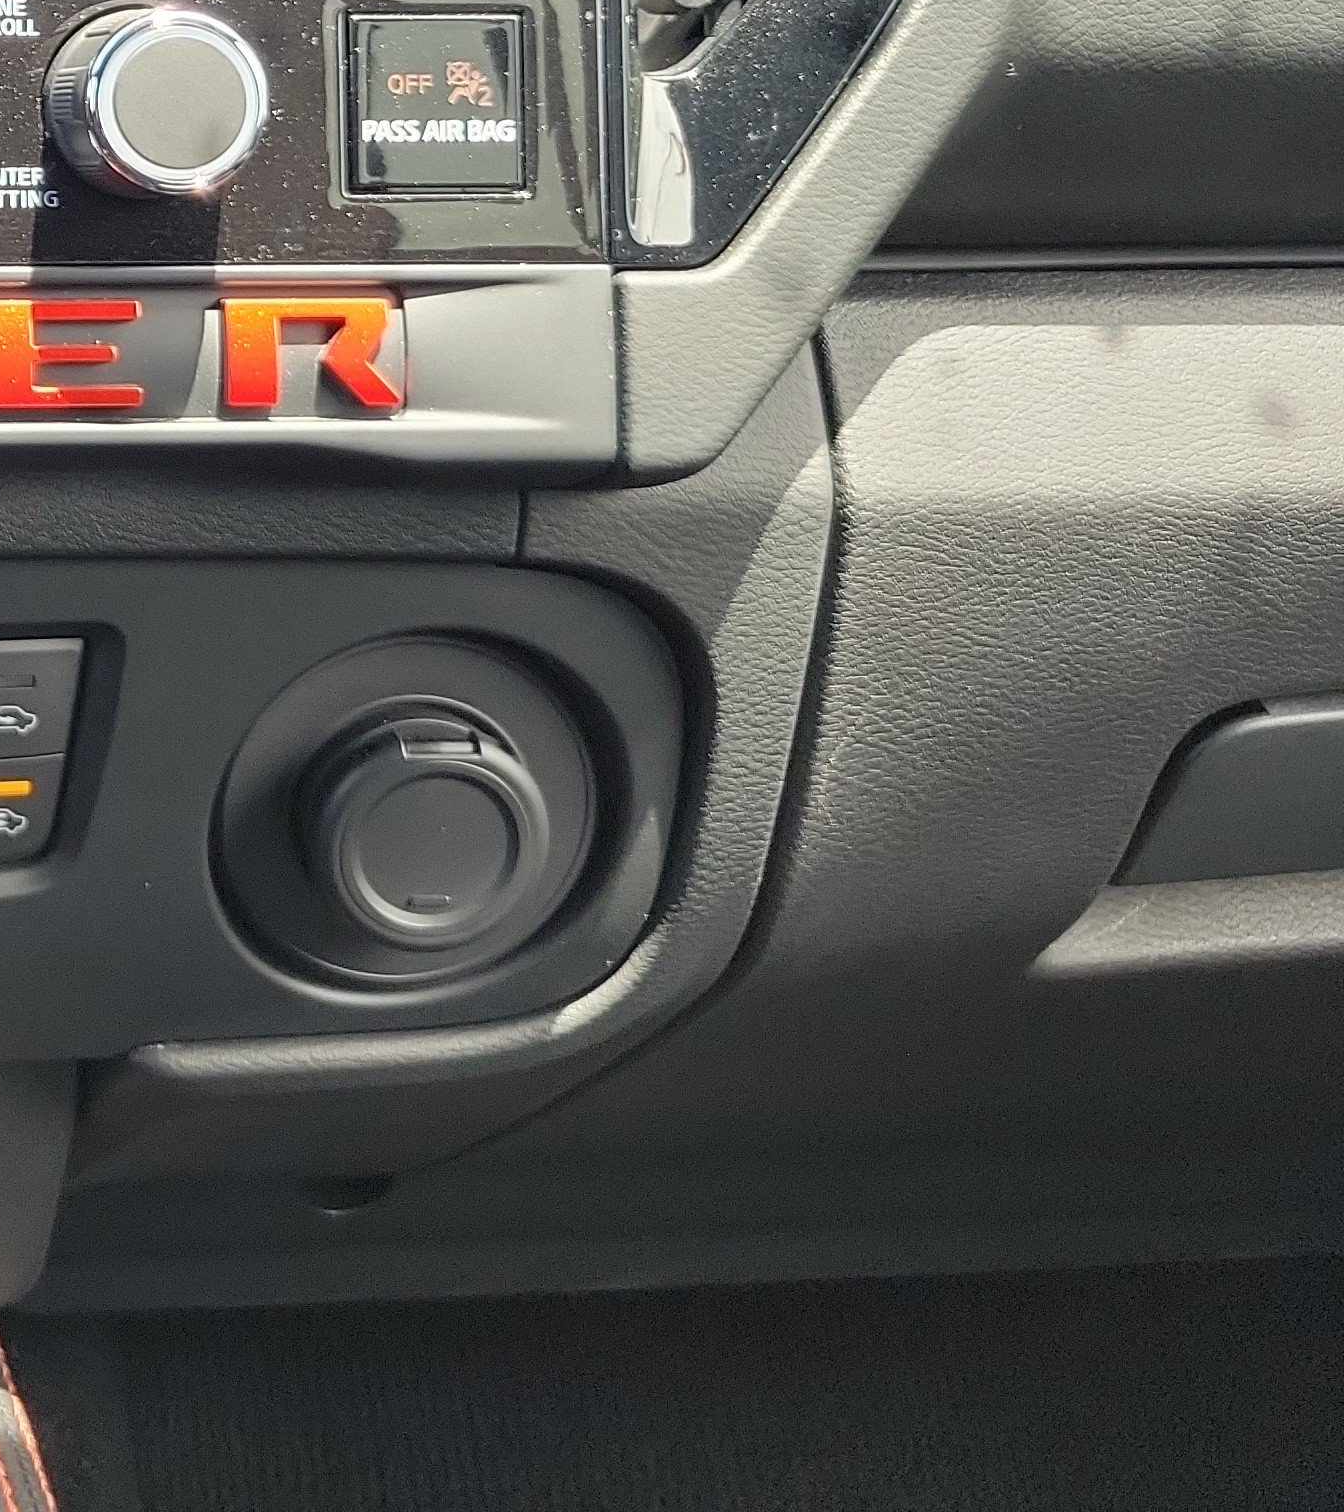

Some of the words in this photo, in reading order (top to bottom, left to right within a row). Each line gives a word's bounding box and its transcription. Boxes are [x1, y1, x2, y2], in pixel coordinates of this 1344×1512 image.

[387, 72, 432, 94] OFF
[361, 120, 422, 143] PASS
[422, 120, 464, 143] AIR
[467, 120, 516, 143] BAG
